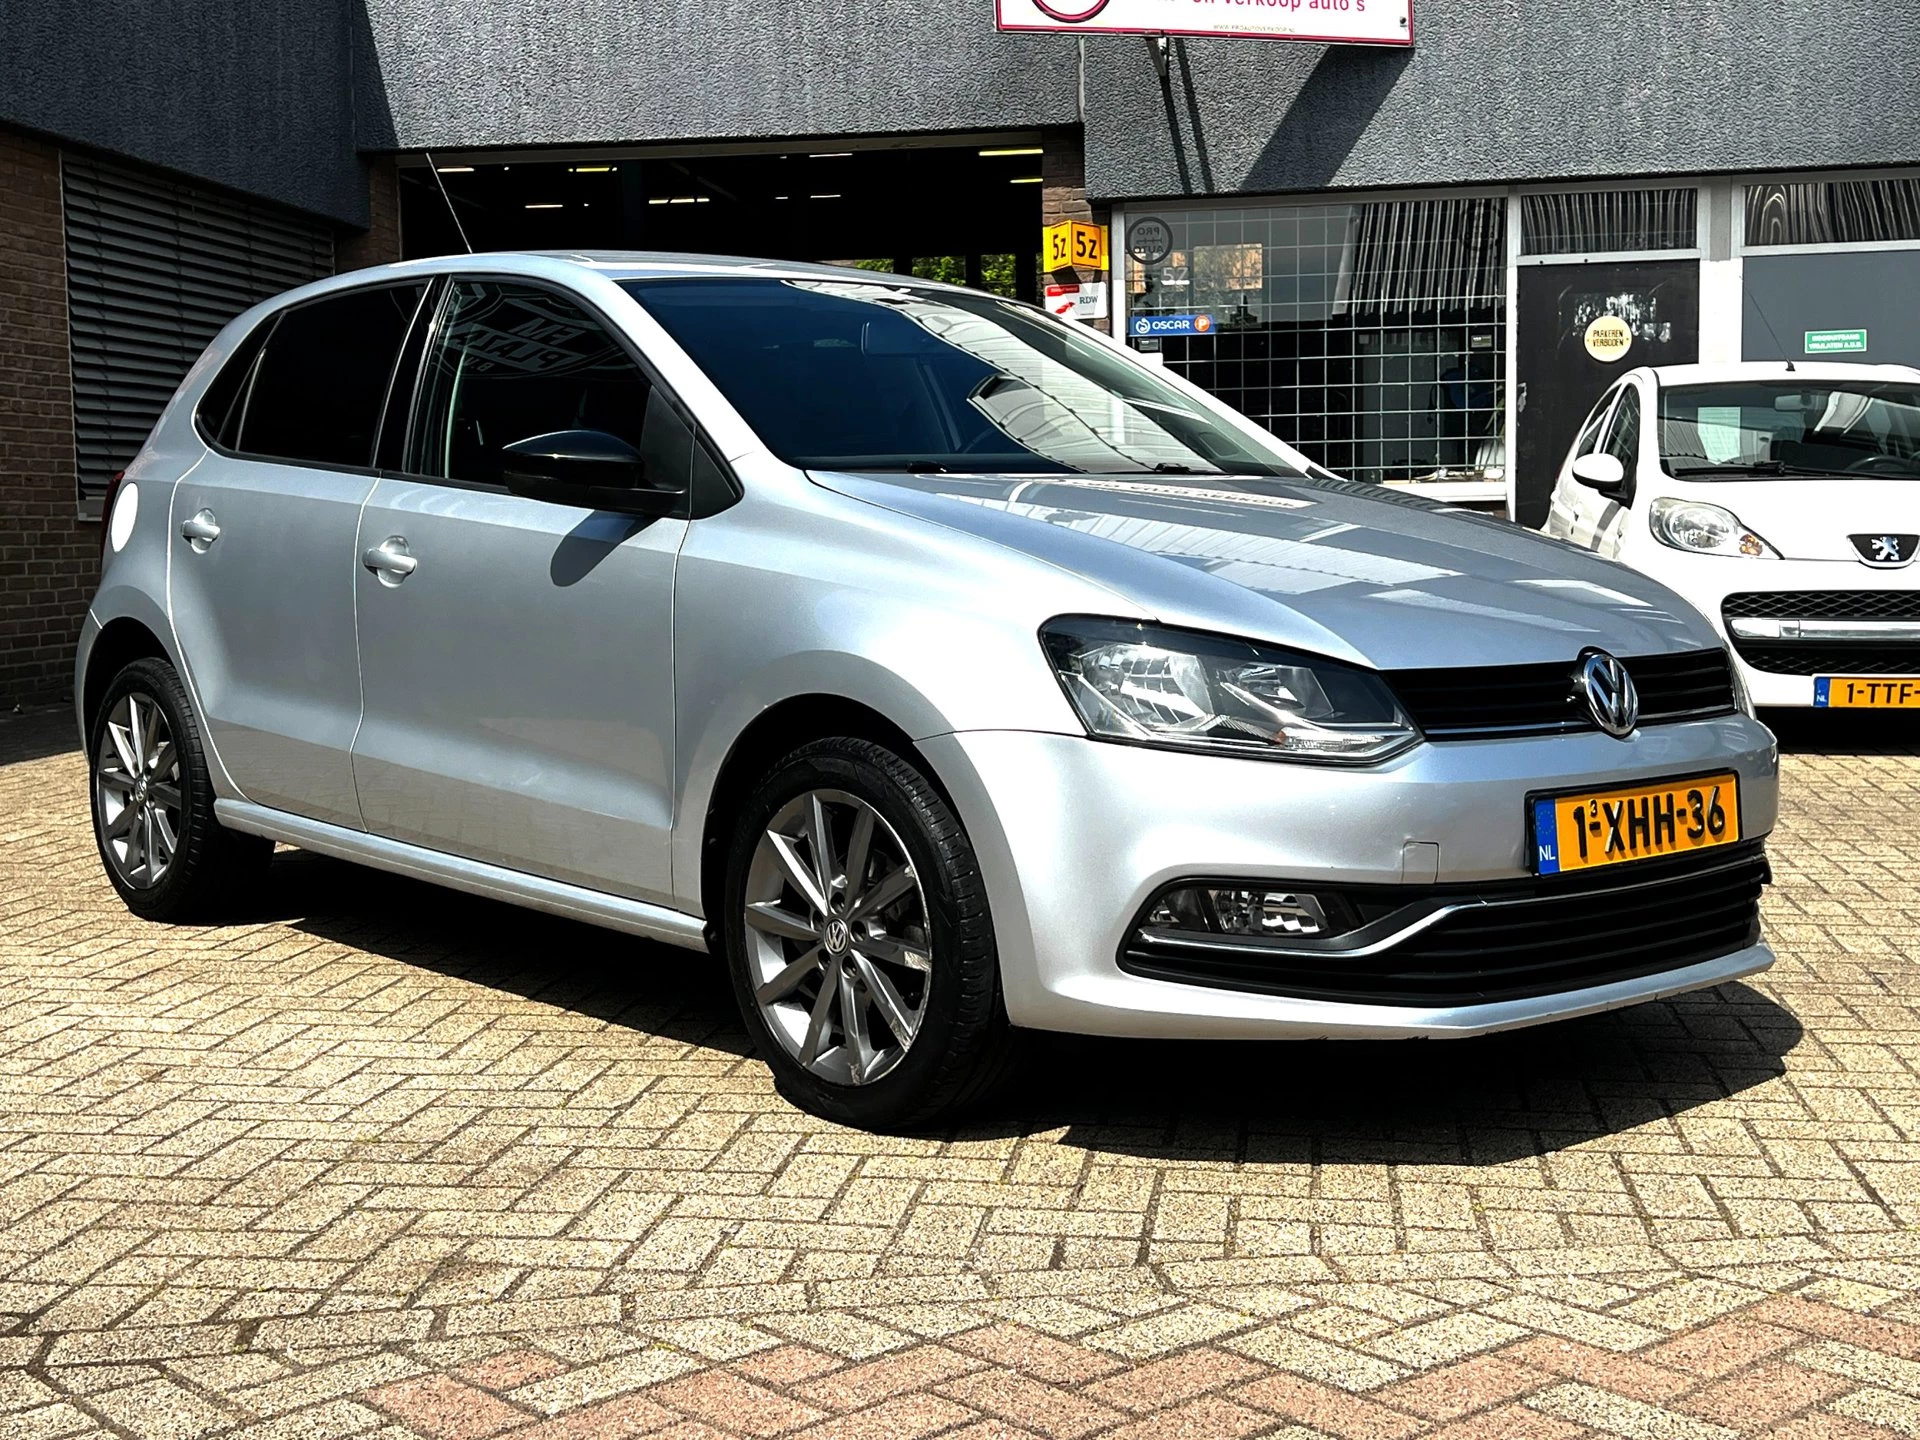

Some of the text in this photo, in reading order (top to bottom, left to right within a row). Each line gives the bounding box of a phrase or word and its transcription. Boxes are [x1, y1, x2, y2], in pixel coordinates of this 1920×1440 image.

[1079, 295, 1099, 305] RDW
[1152, 320, 1190, 330] OSCAR
[1593, 339, 1624, 347] VERBODEN
[1817, 694, 1827, 703] NL
[1539, 845, 1556, 862] NL
